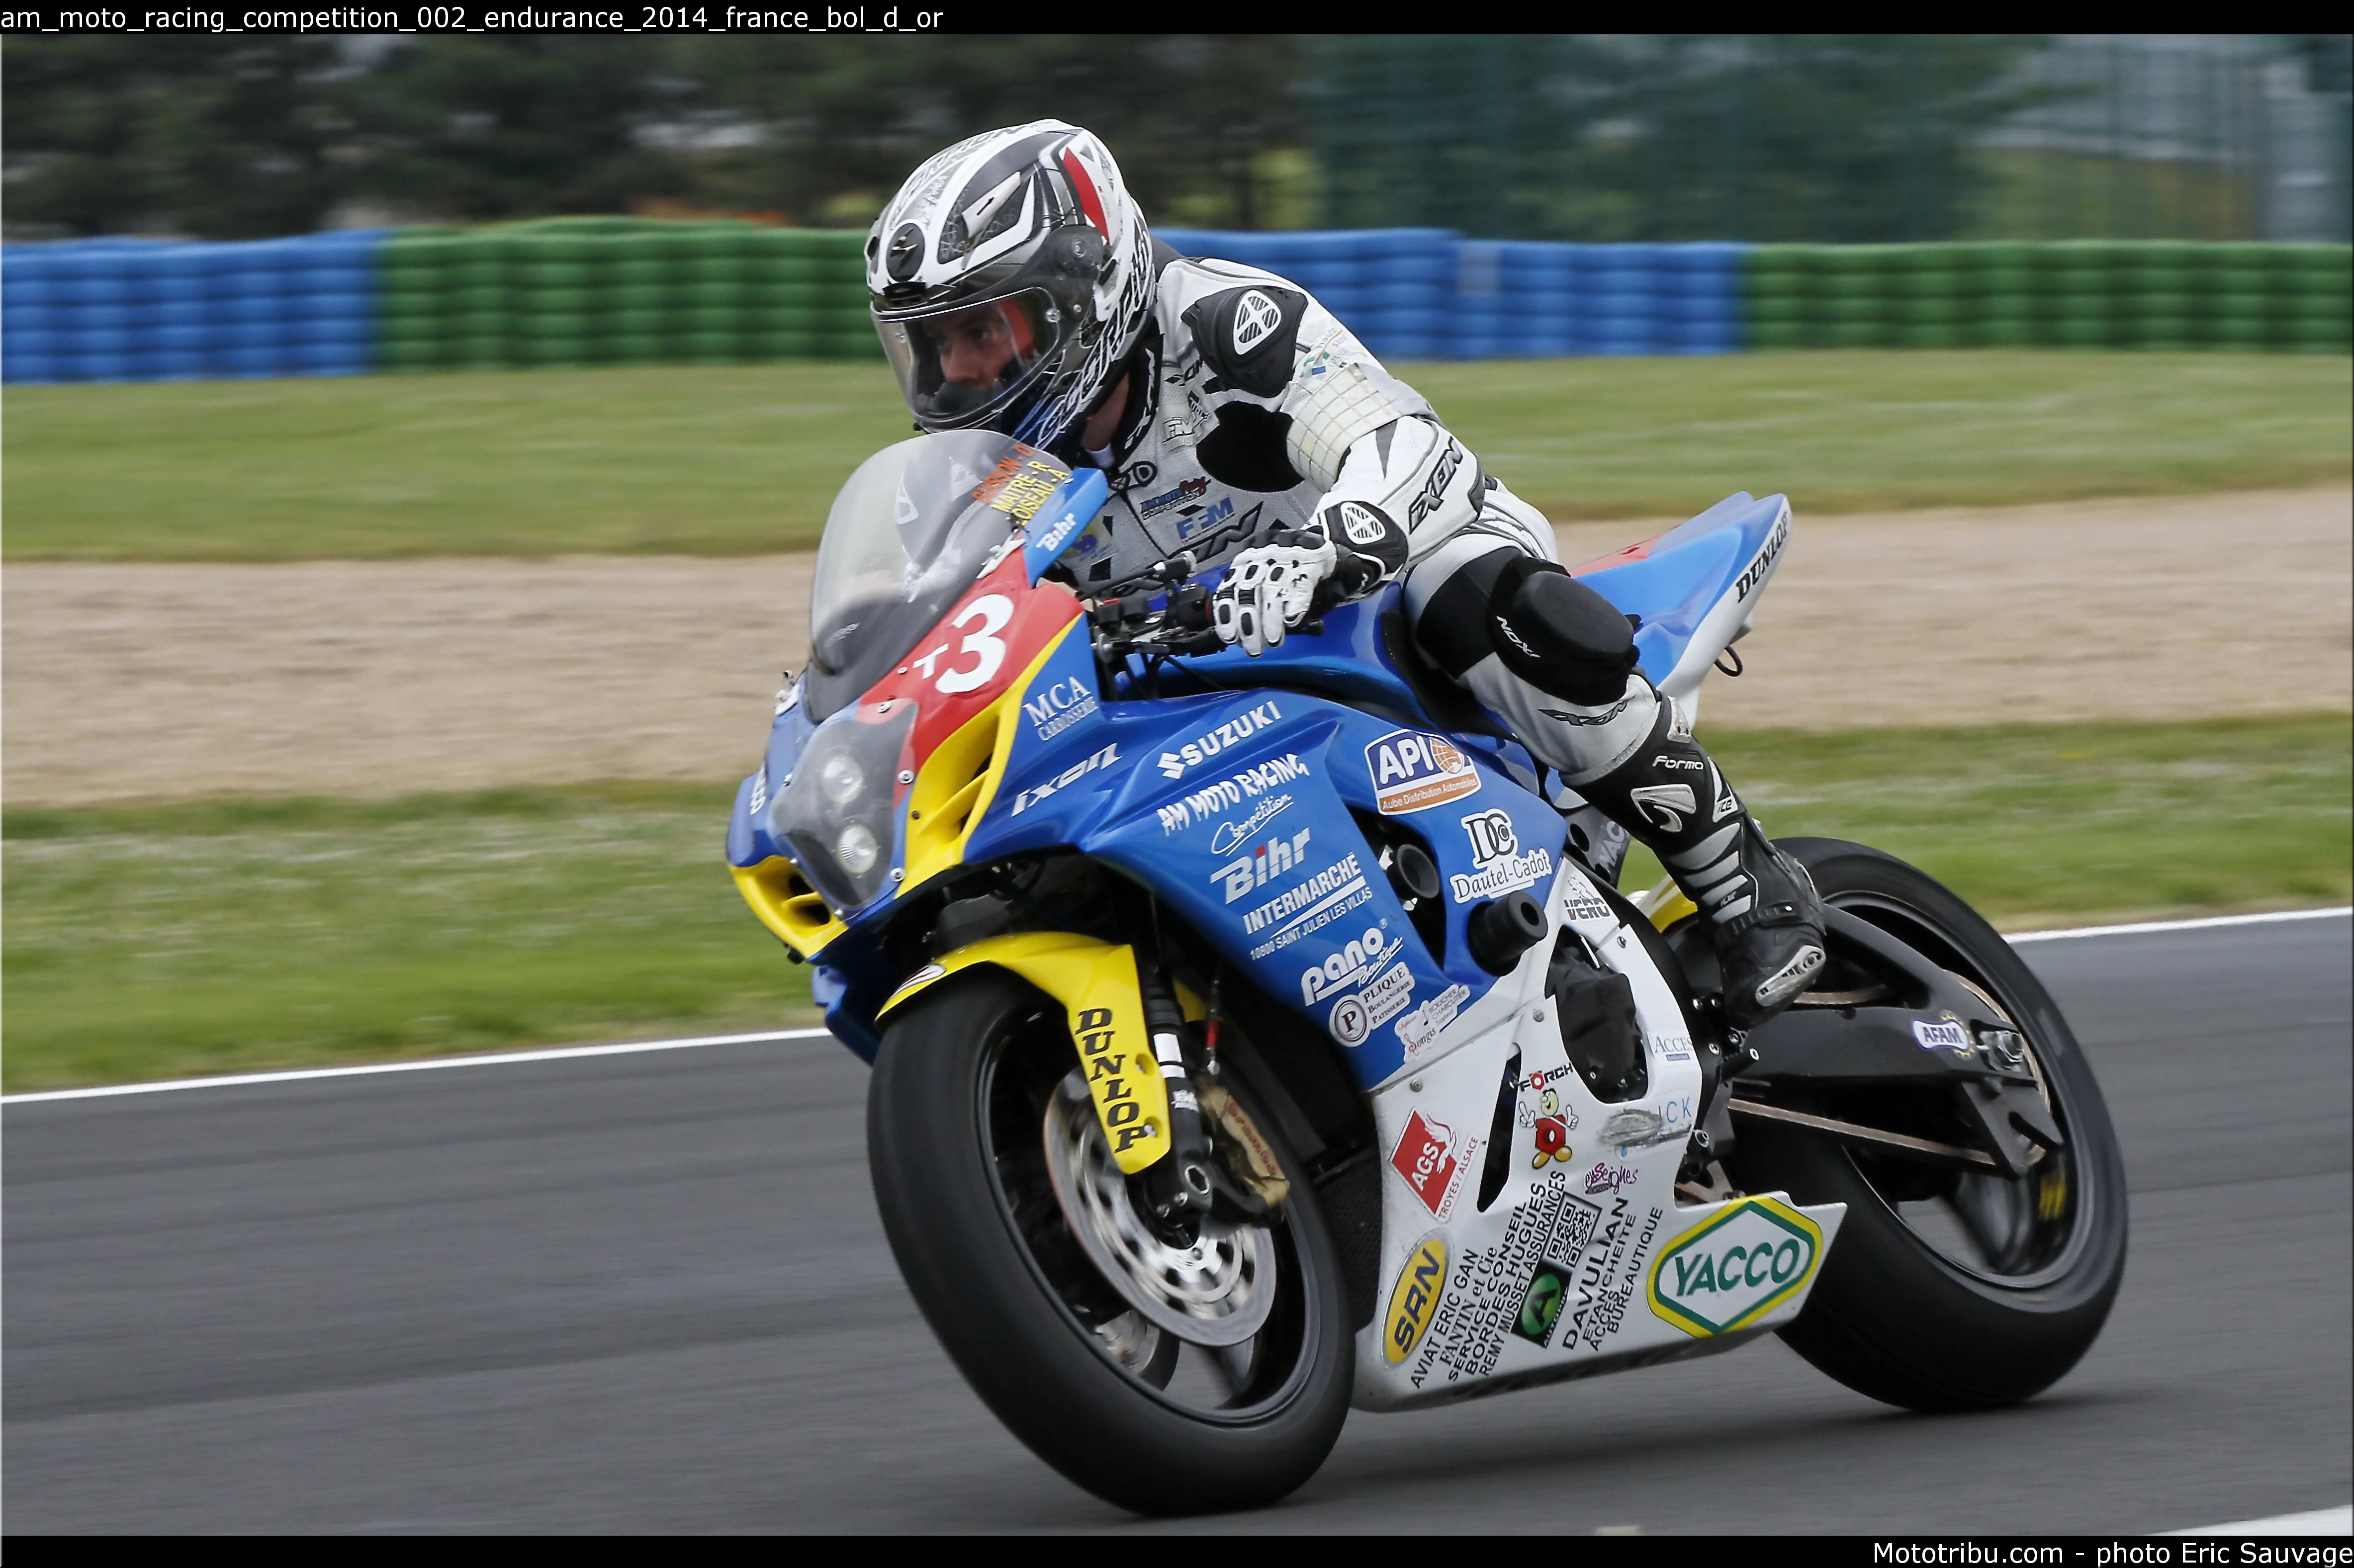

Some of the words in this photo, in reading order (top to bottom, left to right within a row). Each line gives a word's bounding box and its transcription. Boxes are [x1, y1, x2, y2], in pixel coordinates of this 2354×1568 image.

[1736, 511, 1788, 604] DUNLOP
[913, 644, 949, 679] T
[935, 594, 1014, 694] 3
[1022, 676, 1091, 727] MCA
[1180, 700, 1282, 767] SUZUKI
[1157, 803, 1190, 837] AM
[1185, 781, 1241, 822] MOTO
[1233, 753, 1310, 796] RACING
[1379, 735, 1434, 784] API
[1383, 798, 1403, 810] Aube
[1404, 787, 1442, 805] Distribution
[1442, 778, 1477, 793] Automobiles
[1210, 827, 1311, 905] Bihr
[1243, 851, 1361, 935] INTERMARCHÉ
[1455, 852, 1550, 898] Dautel-Cadot
[1275, 926, 1301, 950] SAINT
[1302, 913, 1331, 938] JULIEN
[1330, 902, 1346, 921] LES
[1345, 886, 1373, 913] VILLAS
[1301, 927, 1384, 1006] pano
[1363, 967, 1405, 1003] PLIQUE
[1341, 1011, 1356, 1033] P
[1922, 1026, 1963, 1044] AFAM
[1075, 1008, 1148, 1153] DUNLOP
[1412, 1142, 1439, 1191] AGS
[1439, 1181, 1459, 1218] TROYES
[1459, 1136, 1478, 1175] ALSACE
[1449, 1298, 1490, 1382] SERVICE
[1487, 1202, 1527, 1292] CONSEIL
[1465, 1282, 1511, 1375] BORDES
[1505, 1183, 1546, 1277] HUGUES
[1472, 1278, 1485, 1296] et
[1477, 1247, 1497, 1274] Cie
[1479, 1333, 1505, 1377] REMY
[1498, 1272, 1530, 1333] MUSSET
[1523, 1170, 1566, 1272] ASSURANCES
[1562, 1197, 1629, 1350] DAVULIAN
[1583, 1214, 1636, 1341] ETANCHEITE
[1607, 1207, 1663, 1334] BUREAUTIQUE
[1675, 1238, 1800, 1297] YACCO
[1394, 1248, 1440, 1353] SRN
[1411, 1336, 1441, 1389] AVIAT
[1434, 1293, 1461, 1336] ERIC
[1453, 1248, 1479, 1289] GAN
[1439, 1299, 1476, 1366] FANTIN
[1590, 1291, 1620, 1351] ACCES
